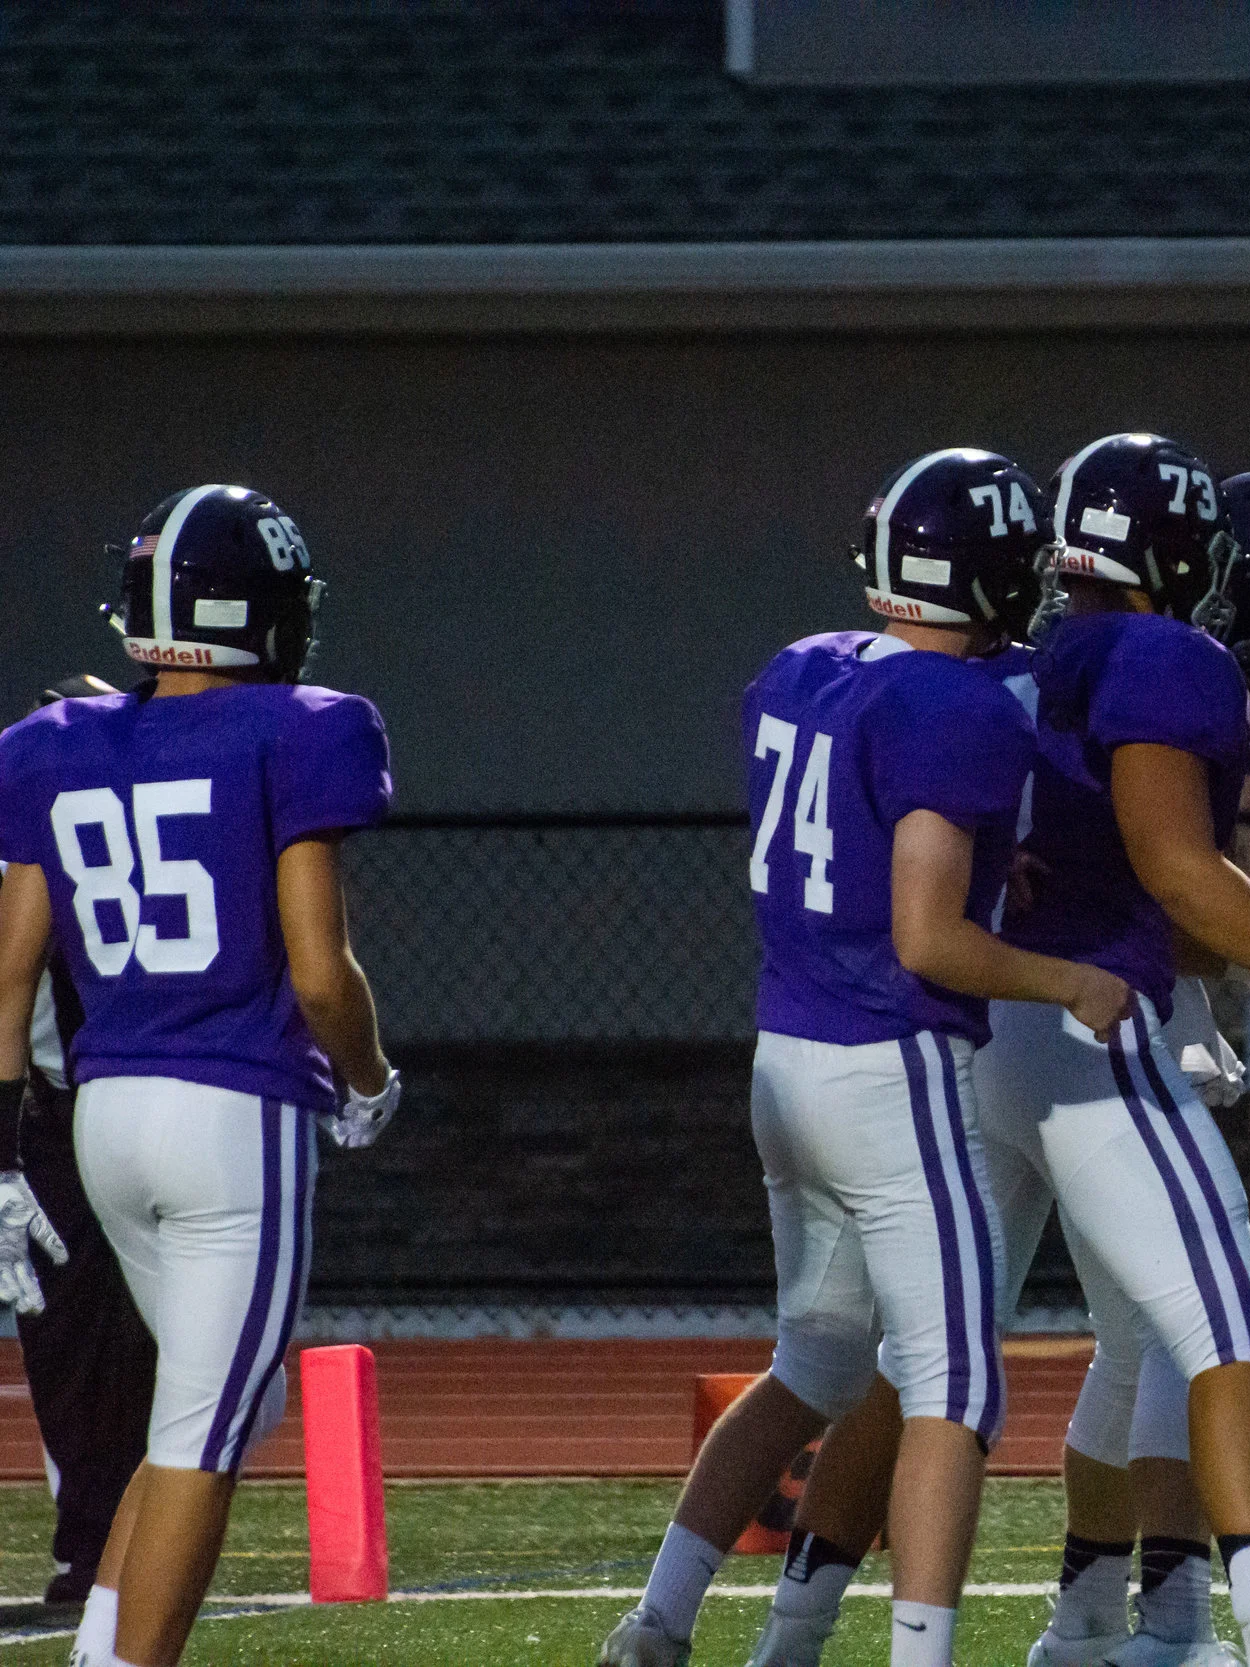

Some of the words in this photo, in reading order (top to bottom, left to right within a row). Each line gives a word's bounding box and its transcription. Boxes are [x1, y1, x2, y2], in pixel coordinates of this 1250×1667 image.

[968, 482, 1038, 538] 74
[1158, 463, 1217, 521] 73
[257, 516, 311, 571] 85
[129, 642, 212, 665] Riddell
[750, 712, 834, 915] 74
[50, 778, 220, 976] 85
